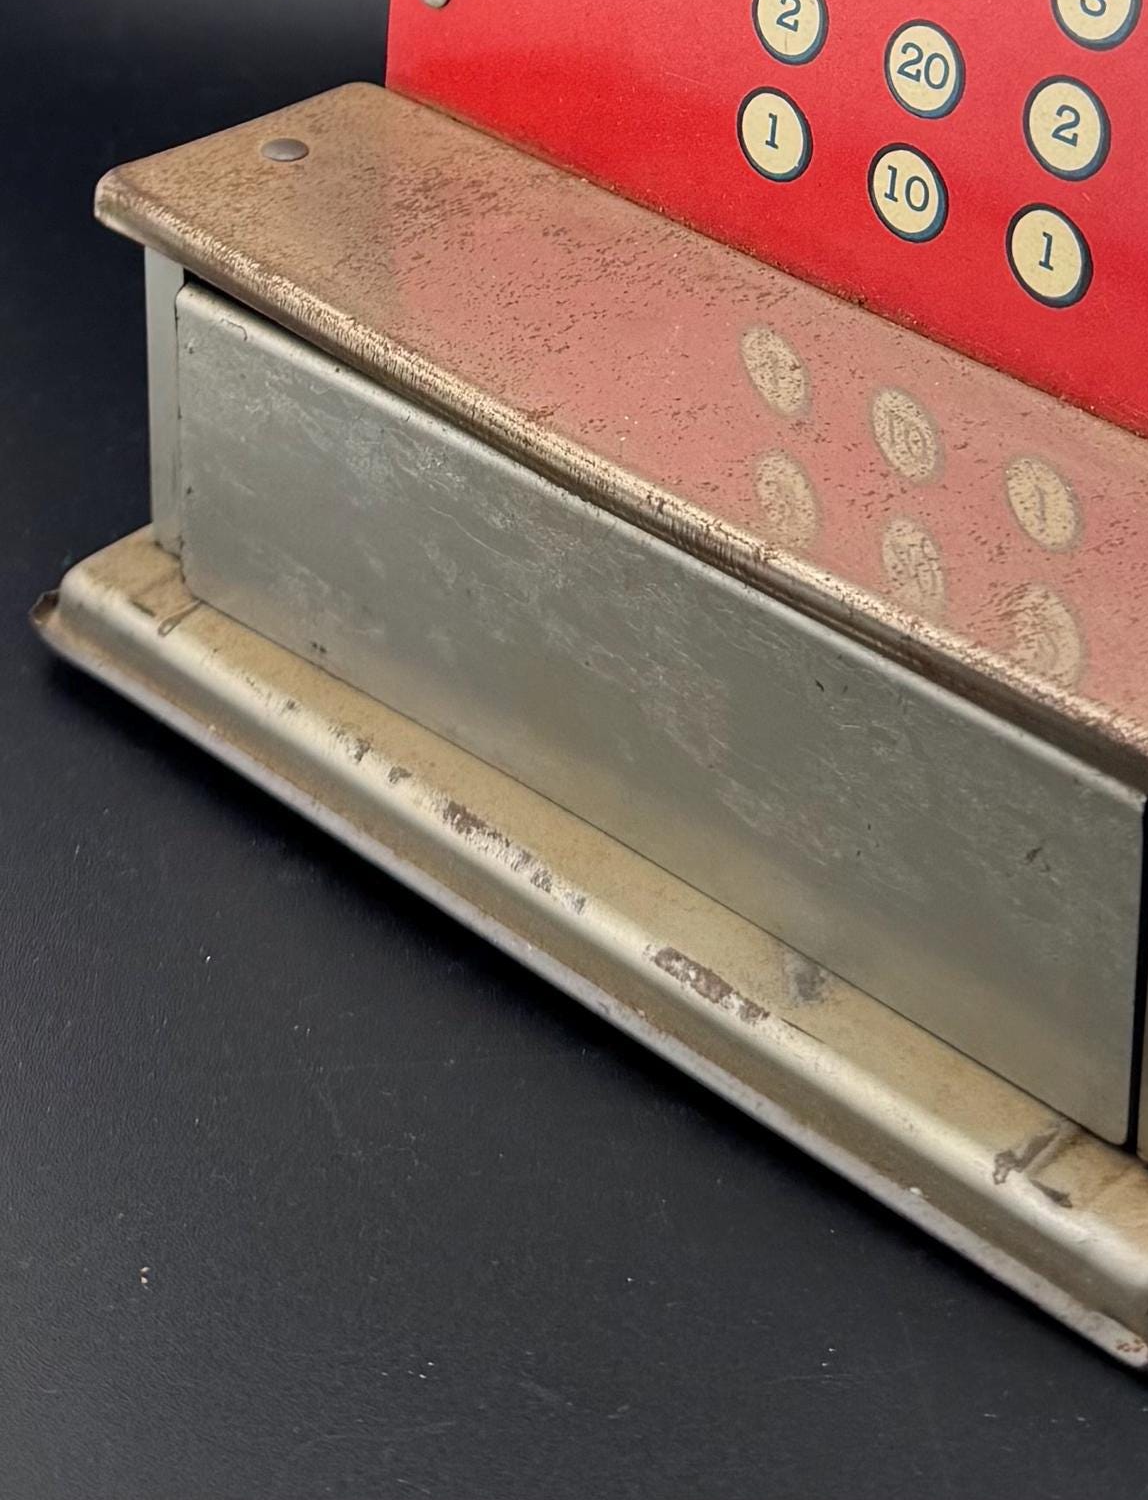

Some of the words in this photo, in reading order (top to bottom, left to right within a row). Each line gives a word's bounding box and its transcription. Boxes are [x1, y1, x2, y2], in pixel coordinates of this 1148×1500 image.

[896, 42, 950, 90] 20
[765, 112, 779, 150] 1
[1051, 104, 1081, 148] 2
[883, 164, 930, 213] 10
[1038, 231, 1054, 272] 1
